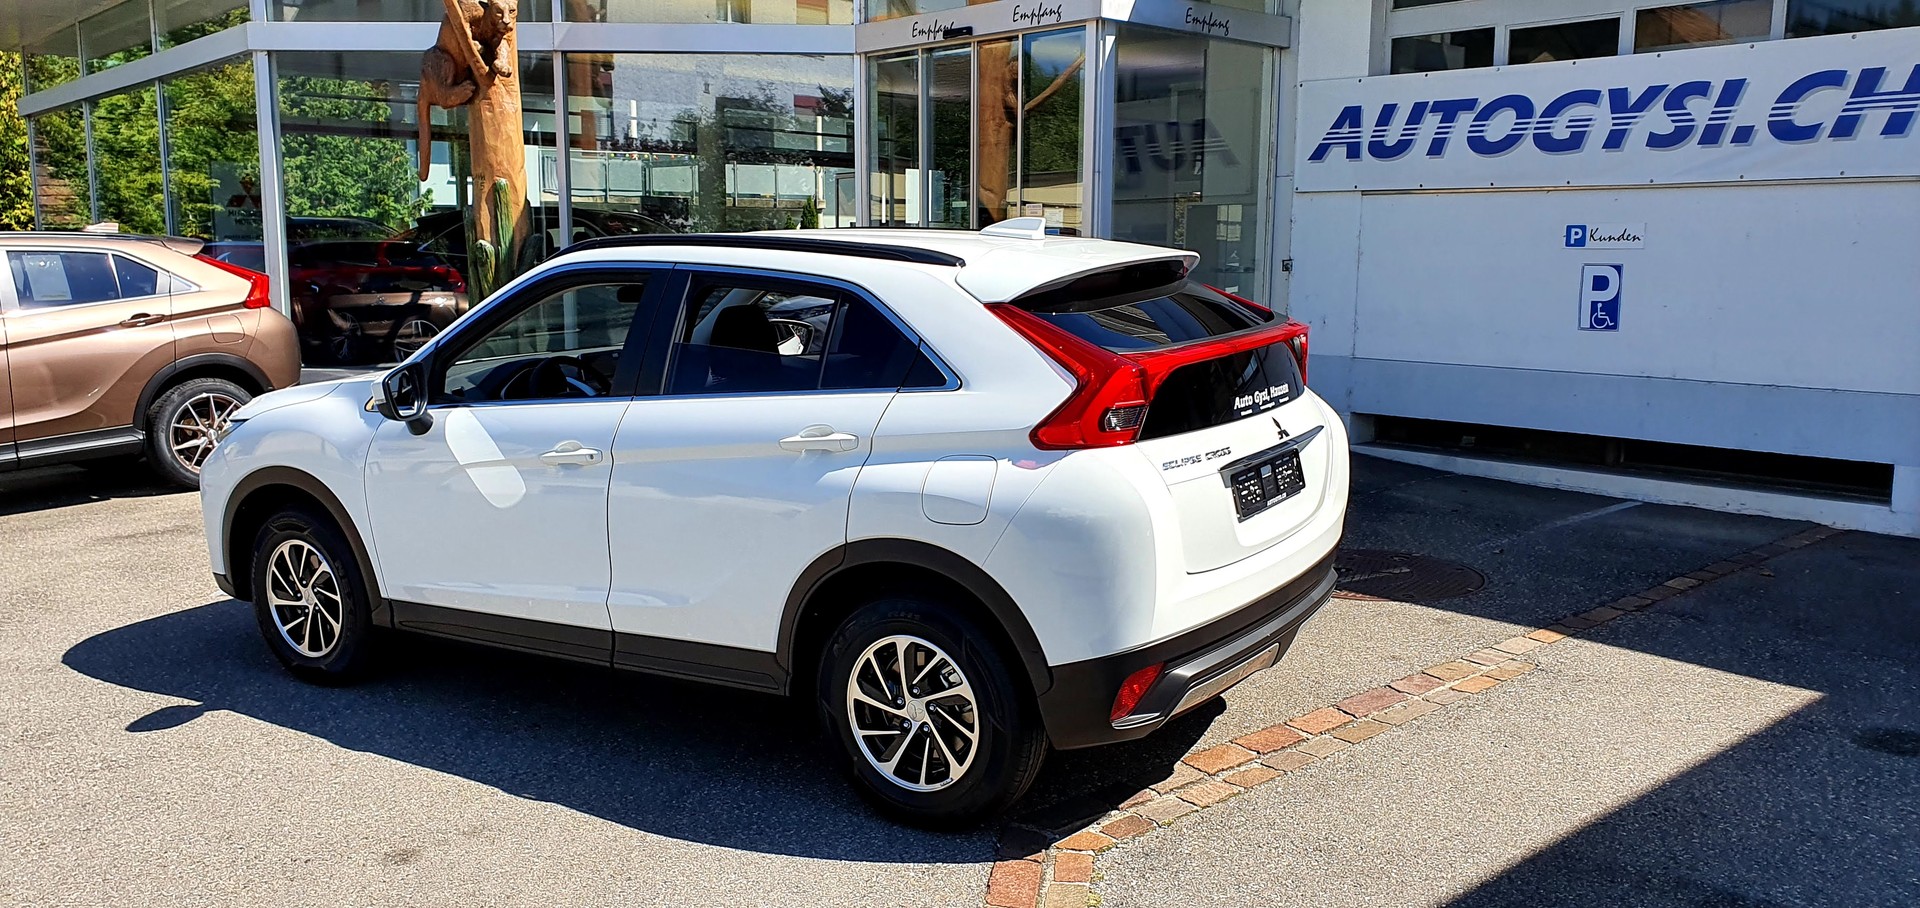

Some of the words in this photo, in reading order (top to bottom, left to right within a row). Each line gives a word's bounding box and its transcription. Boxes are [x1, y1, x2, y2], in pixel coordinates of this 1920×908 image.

[1013, 2, 1062, 25] Empfang
[1185, 7, 1230, 36] Empfang
[1307, 64, 1920, 162] AUTOGYSI.CH
[1570, 228, 1583, 245] P
[1589, 227, 1641, 242] Kunden
[1581, 265, 1620, 328] P
[1234, 395, 1253, 410] Auto
